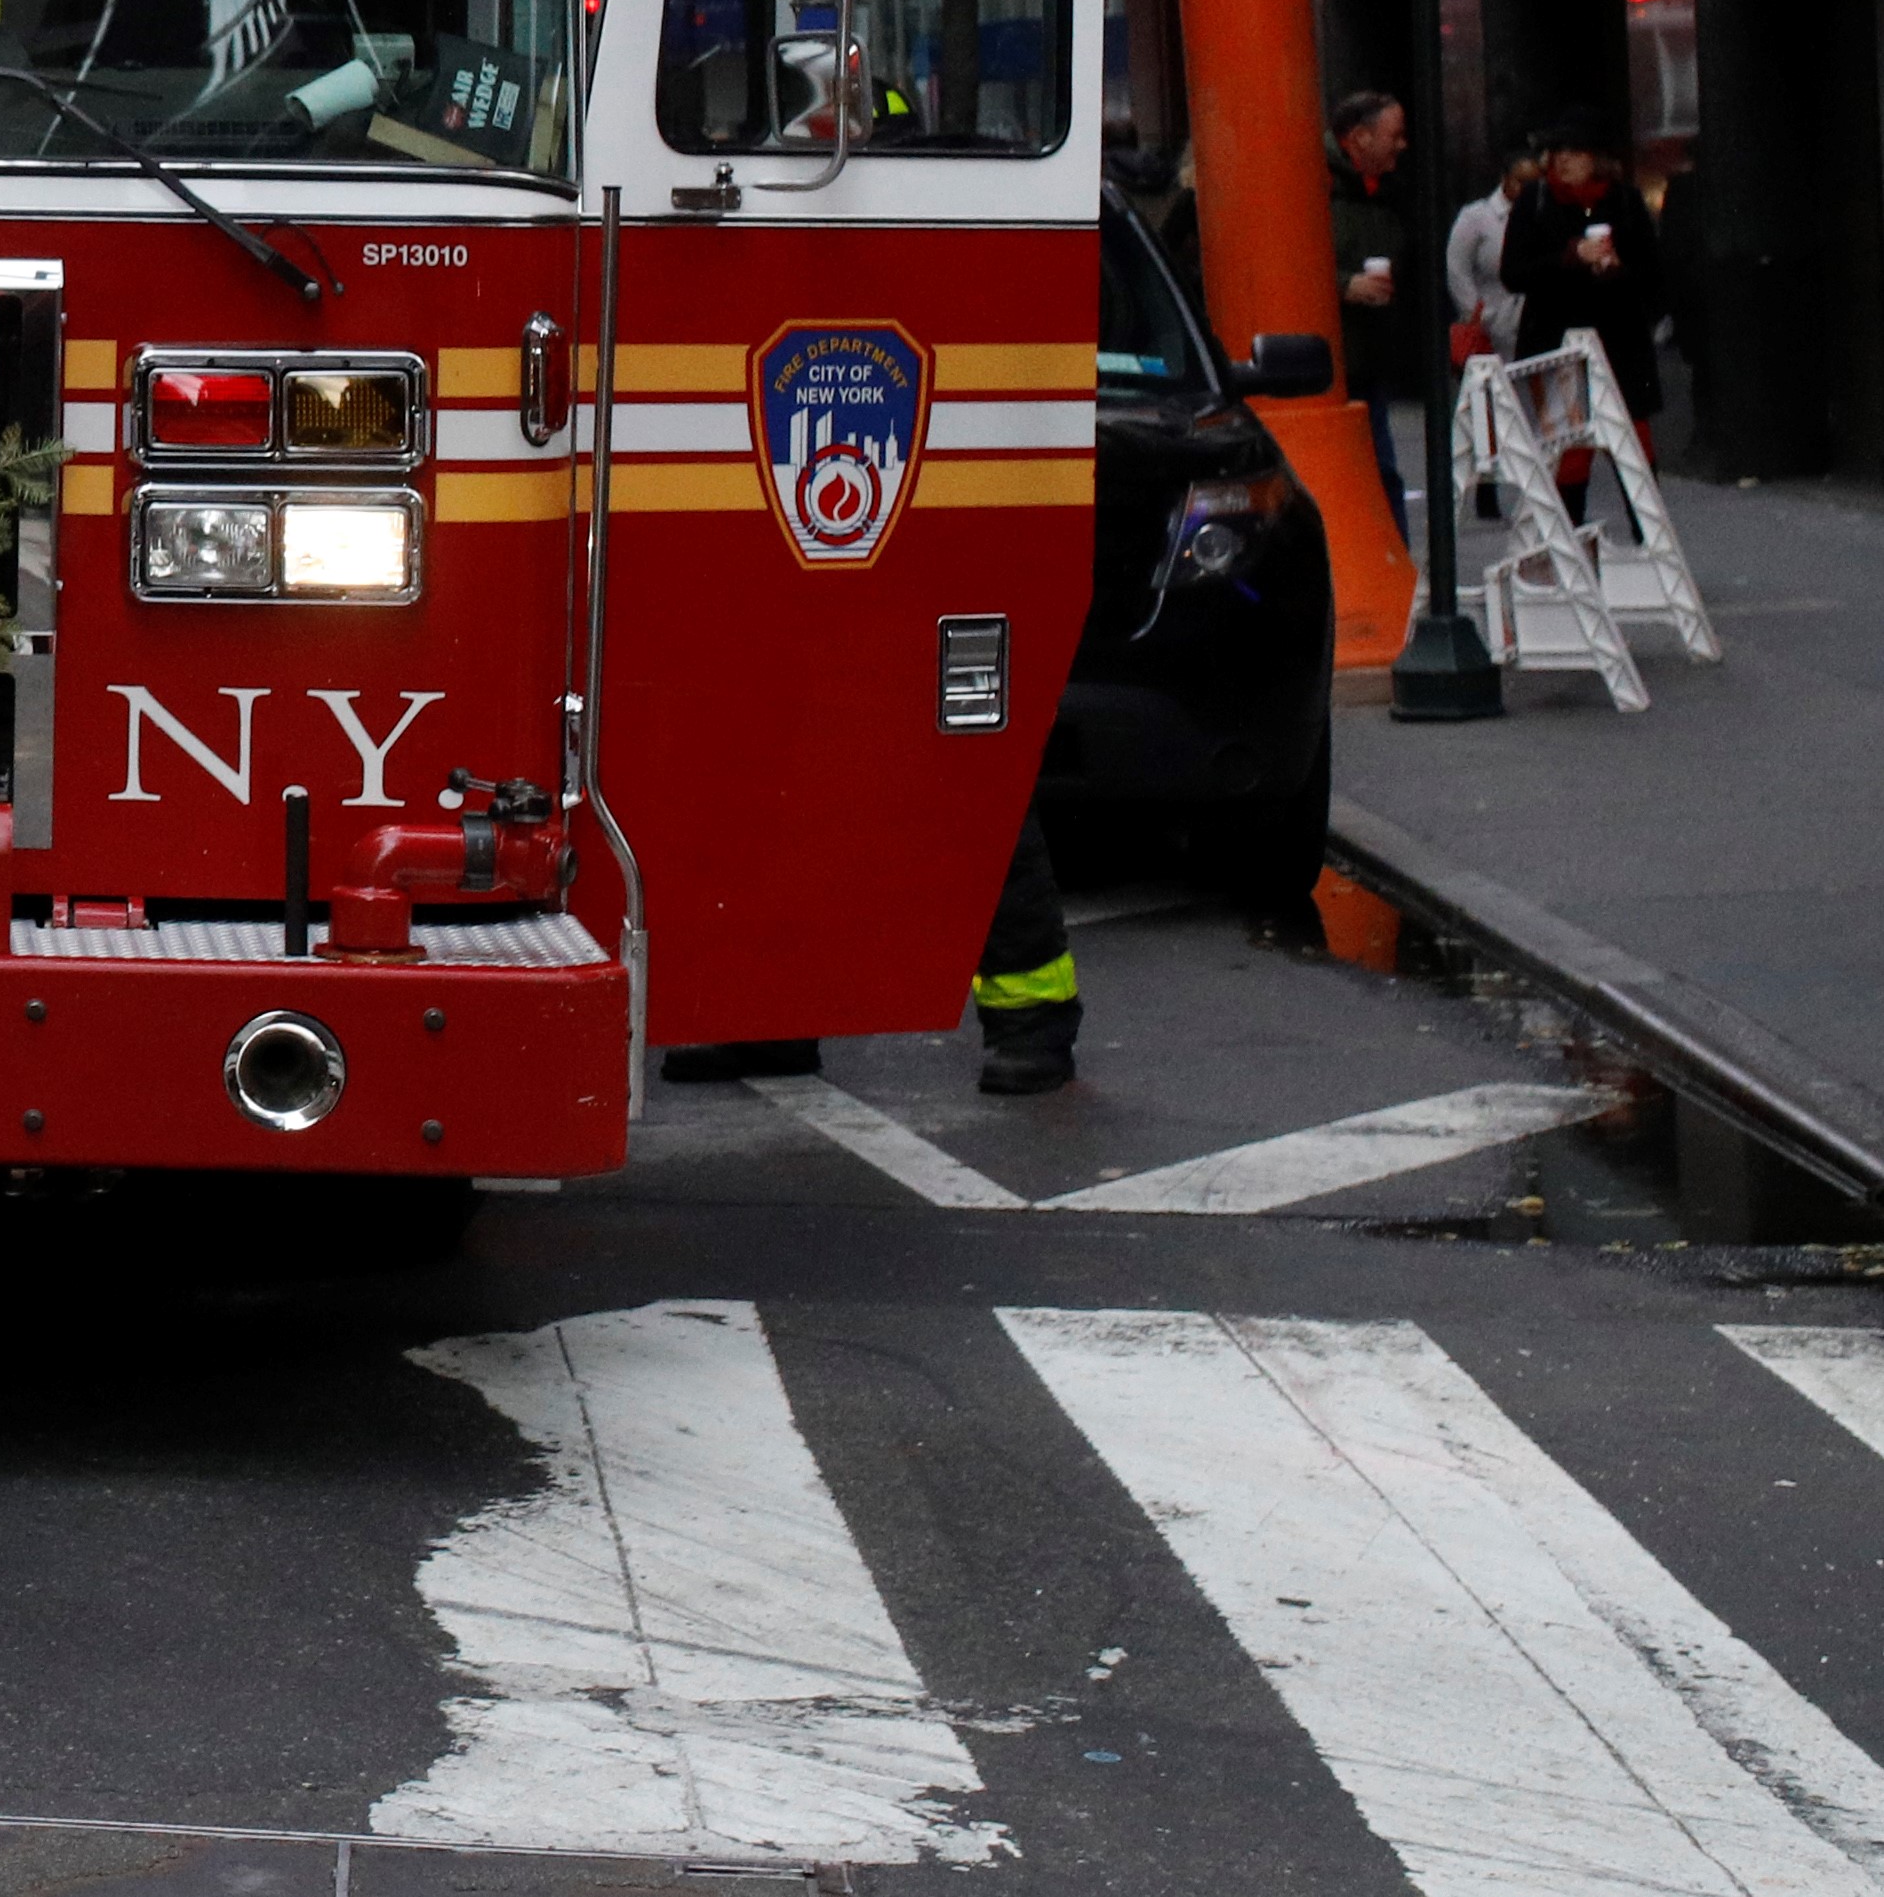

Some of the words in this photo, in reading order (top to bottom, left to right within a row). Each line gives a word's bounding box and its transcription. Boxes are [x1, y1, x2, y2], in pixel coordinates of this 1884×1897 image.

[450, 68, 475, 110] AIR
[467, 61, 499, 129] WEDGE
[362, 243, 469, 267] SP13010
[773, 353, 805, 394] FIRE
[806, 337, 909, 390] DEPARTMENT
[808, 365, 846, 383] CITY
[849, 365, 873, 383] OF
[796, 386, 835, 405] NEW
[838, 386, 885, 405] YORK
